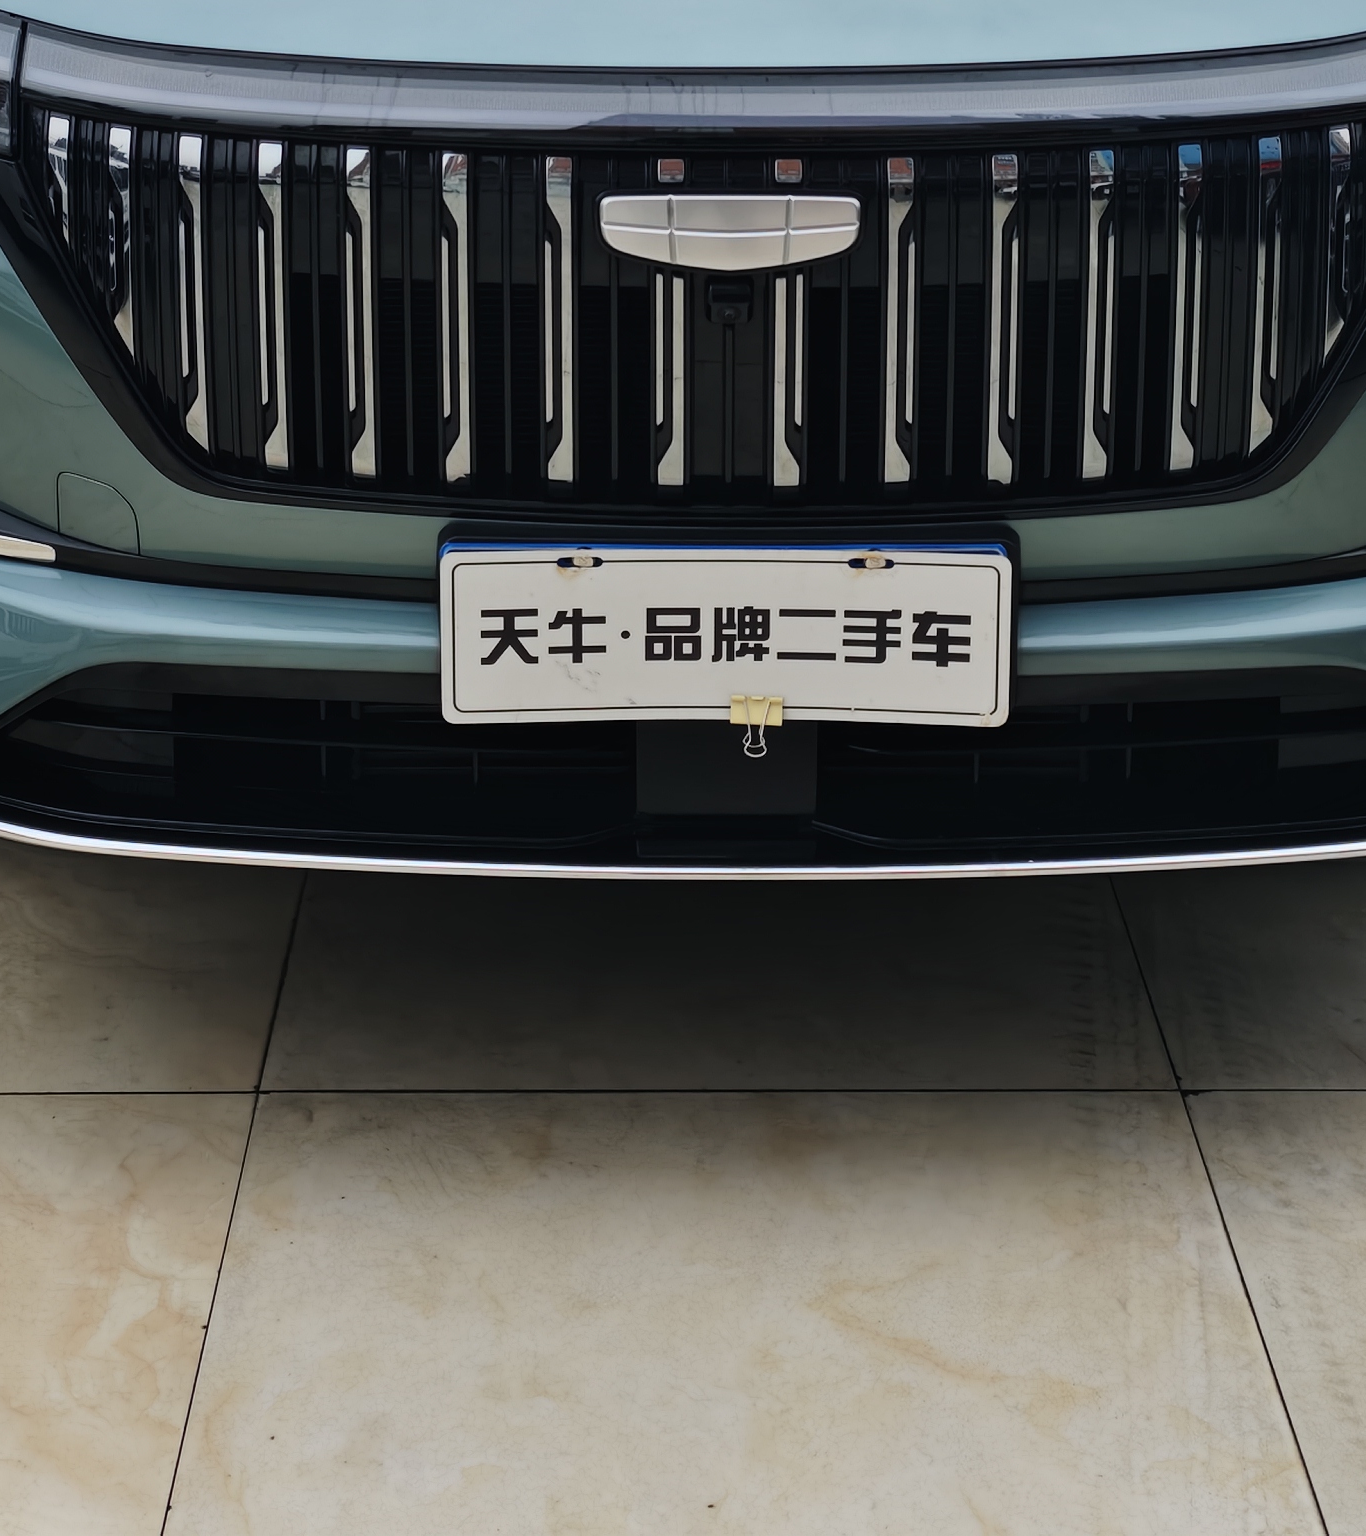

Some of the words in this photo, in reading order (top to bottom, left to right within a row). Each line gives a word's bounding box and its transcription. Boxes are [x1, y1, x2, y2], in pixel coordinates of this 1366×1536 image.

[480, 605, 972, 668] 天牛·品牌二手车
